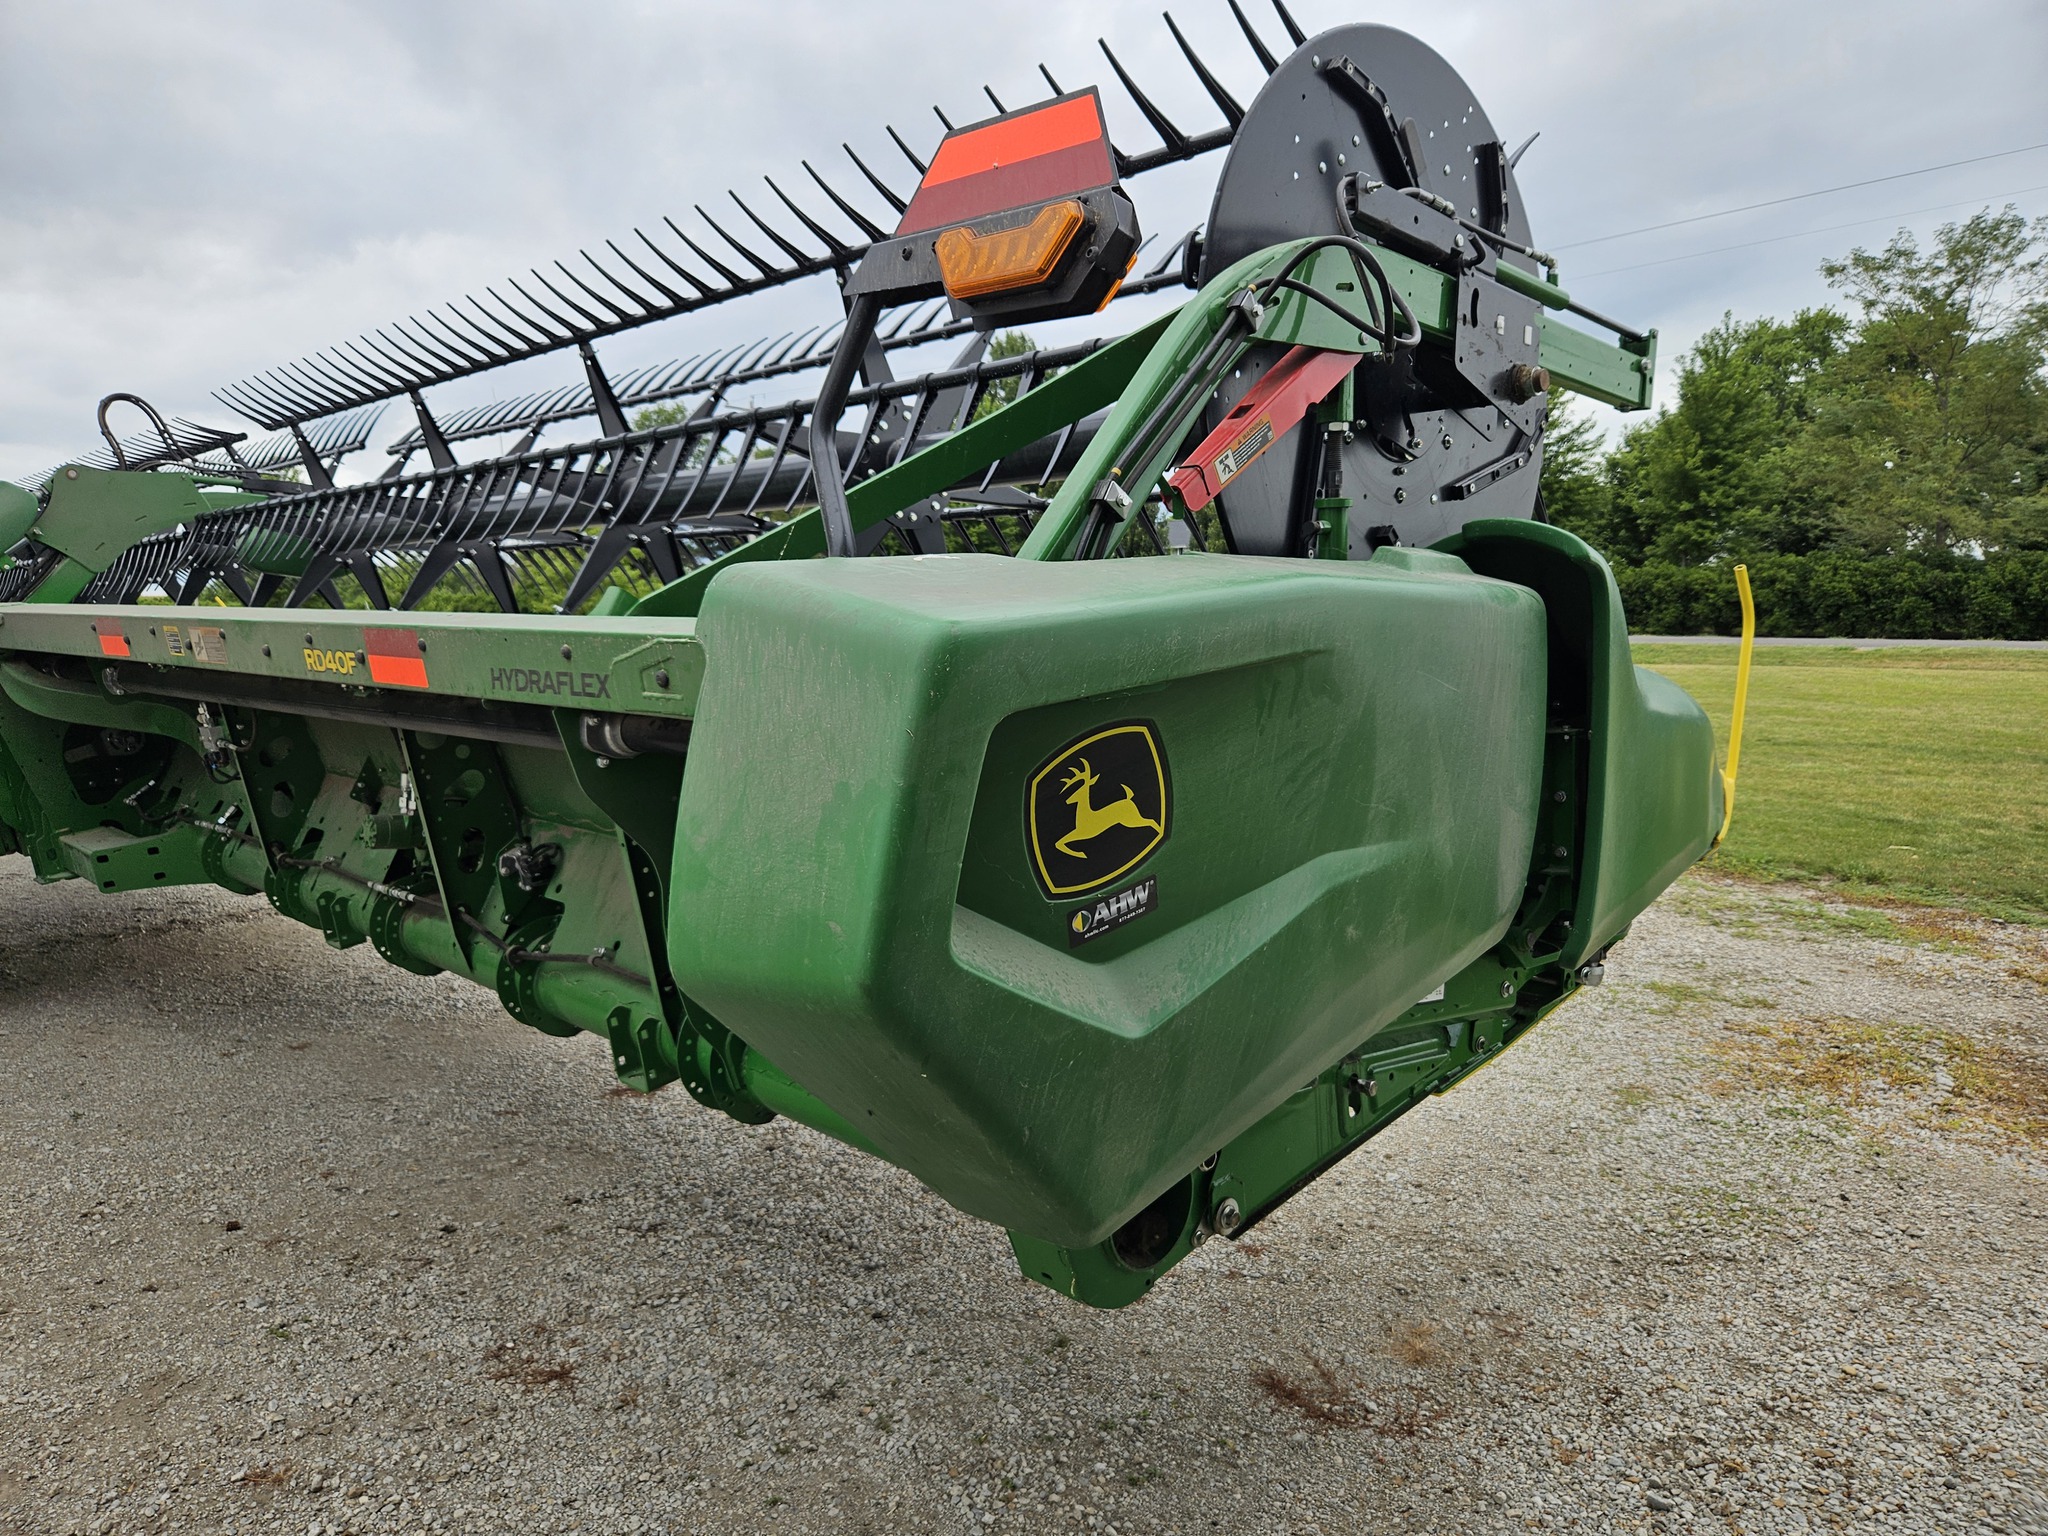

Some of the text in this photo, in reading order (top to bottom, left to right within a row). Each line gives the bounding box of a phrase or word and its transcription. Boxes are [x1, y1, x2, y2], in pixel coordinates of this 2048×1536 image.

[303, 648, 356, 675] RD40F
[490, 667, 612, 699] HYDRAFLEX
[1091, 881, 1150, 928] AHW
